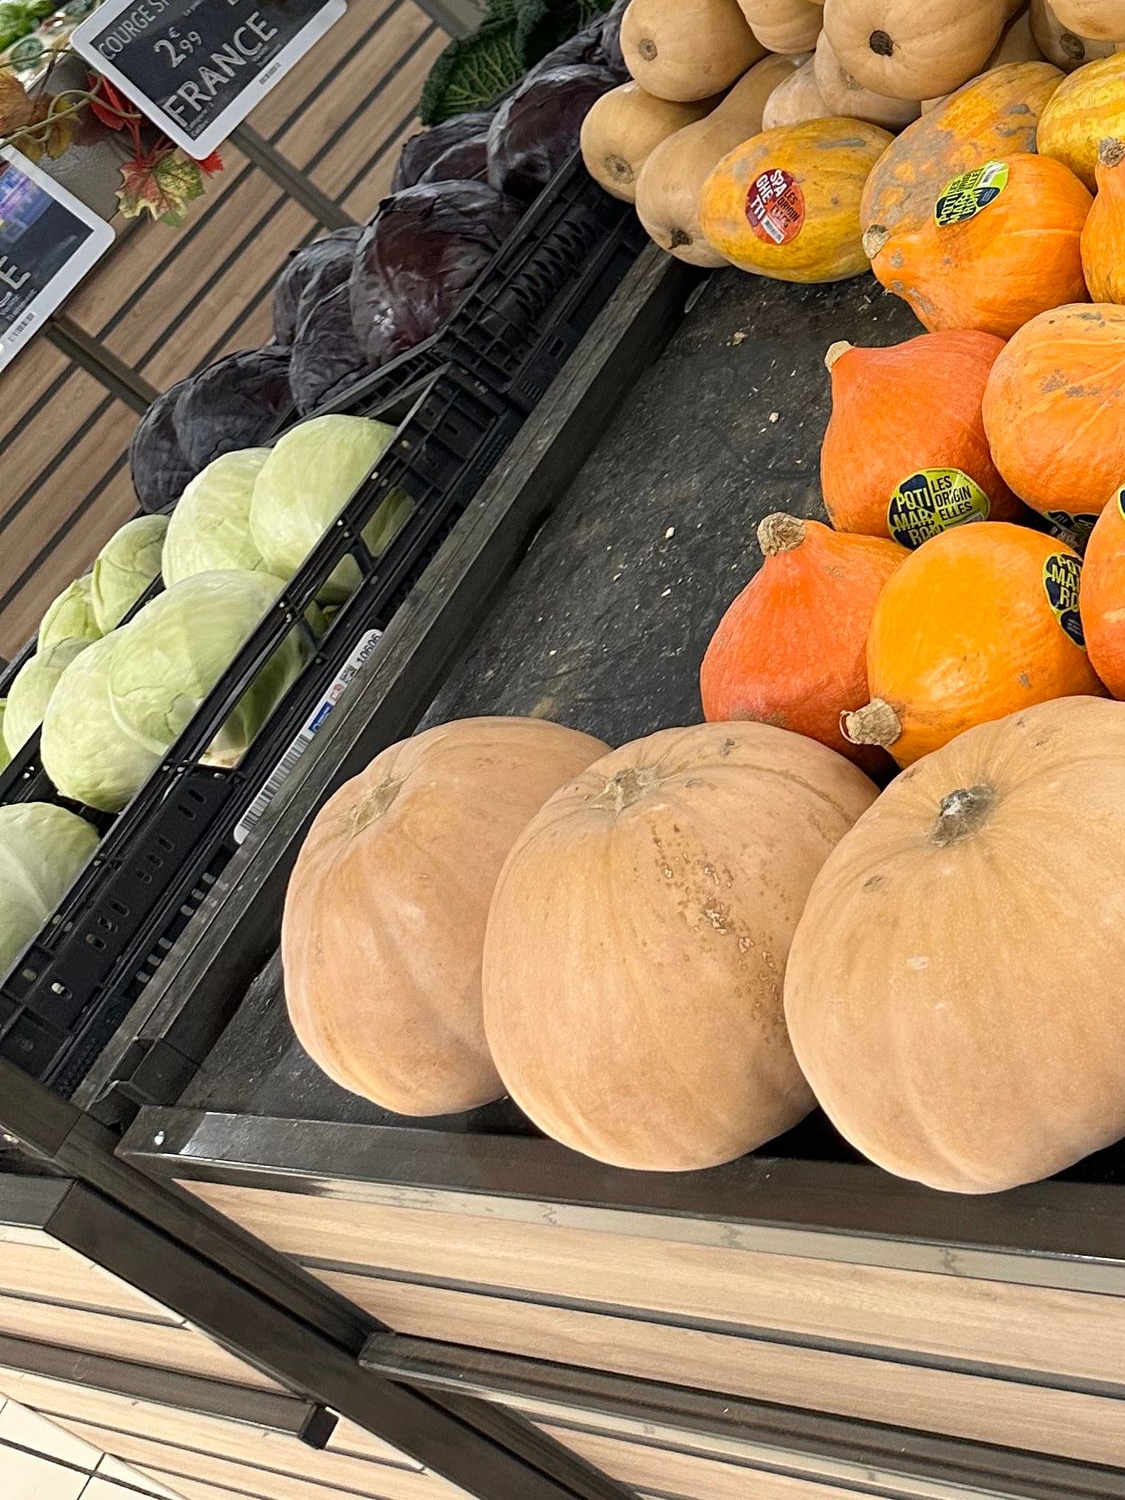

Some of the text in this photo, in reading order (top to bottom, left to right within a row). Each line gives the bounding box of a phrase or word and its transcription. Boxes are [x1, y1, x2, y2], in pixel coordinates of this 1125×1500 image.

[98, 4, 157, 61] COURGE
[162, 11, 278, 129] FRANCE
[756, 174, 773, 204] GHE
[770, 169, 788, 197] SPA
[784, 188, 798, 205] LES
[750, 194, 767, 220] TTI
[777, 196, 800, 223] ORIGIN
[930, 475, 953, 493] LES
[934, 485, 972, 508] ORIGIN
[896, 487, 932, 513] POTI
[939, 501, 973, 521] ELLES
[1051, 563, 1079, 591] MA
[356, 632, 382, 664] 10606
